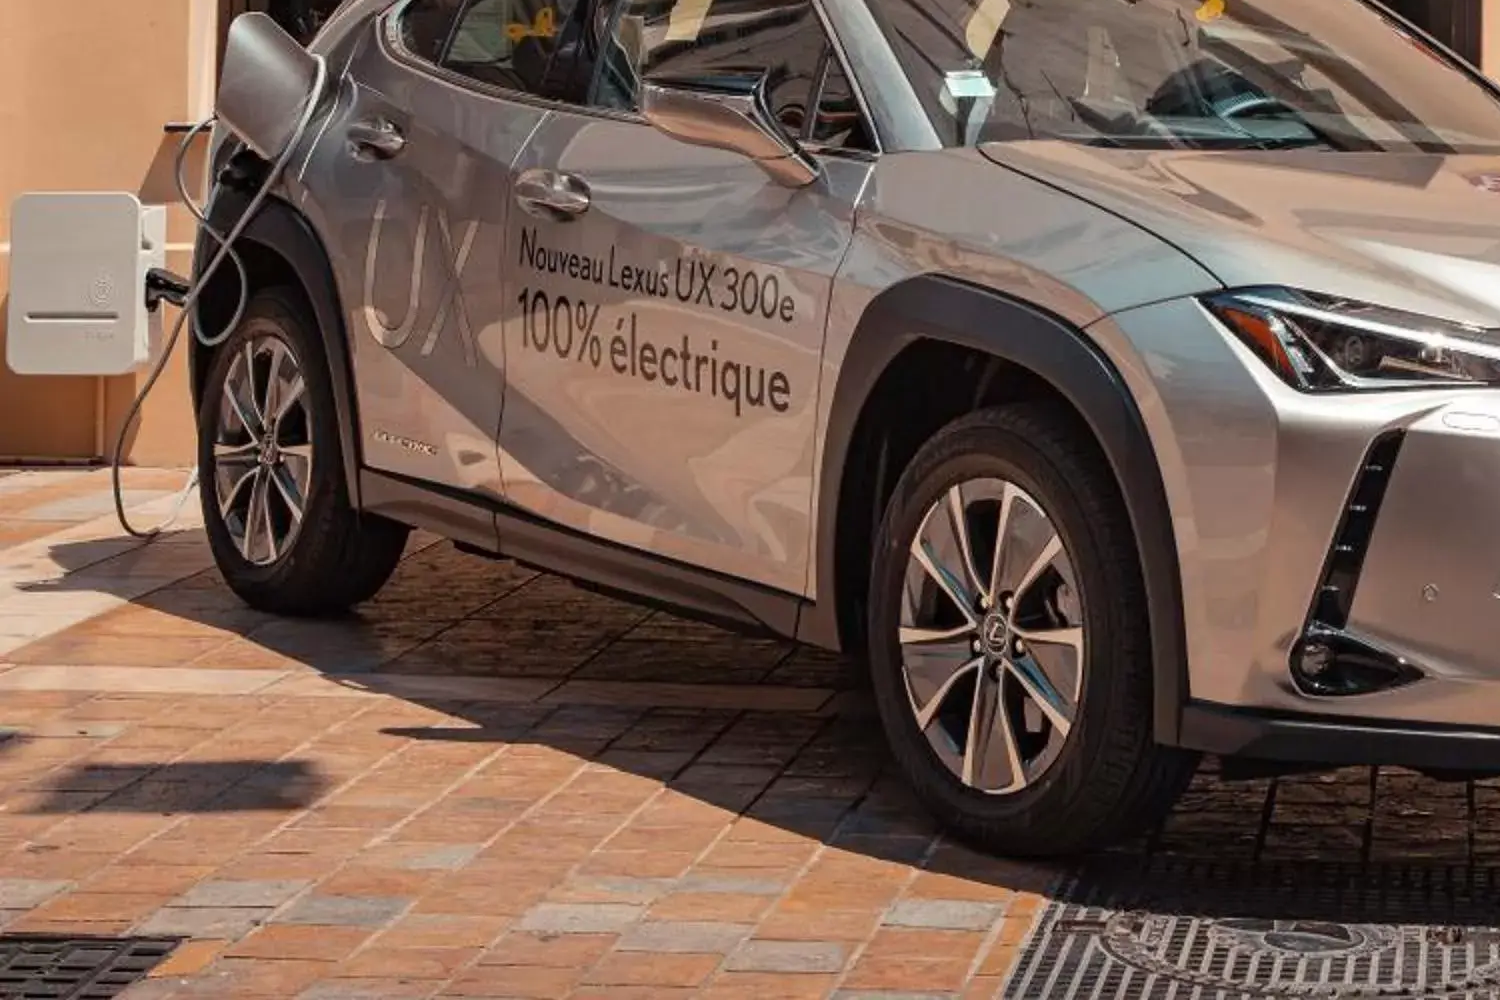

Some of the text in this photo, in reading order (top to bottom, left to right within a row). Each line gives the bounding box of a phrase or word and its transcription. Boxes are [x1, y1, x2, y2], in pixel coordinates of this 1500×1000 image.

[364, 199, 480, 367] UX
[519, 228, 795, 323] Nouveau Lexus UX 300e
[517, 287, 793, 417] 100% électrique
